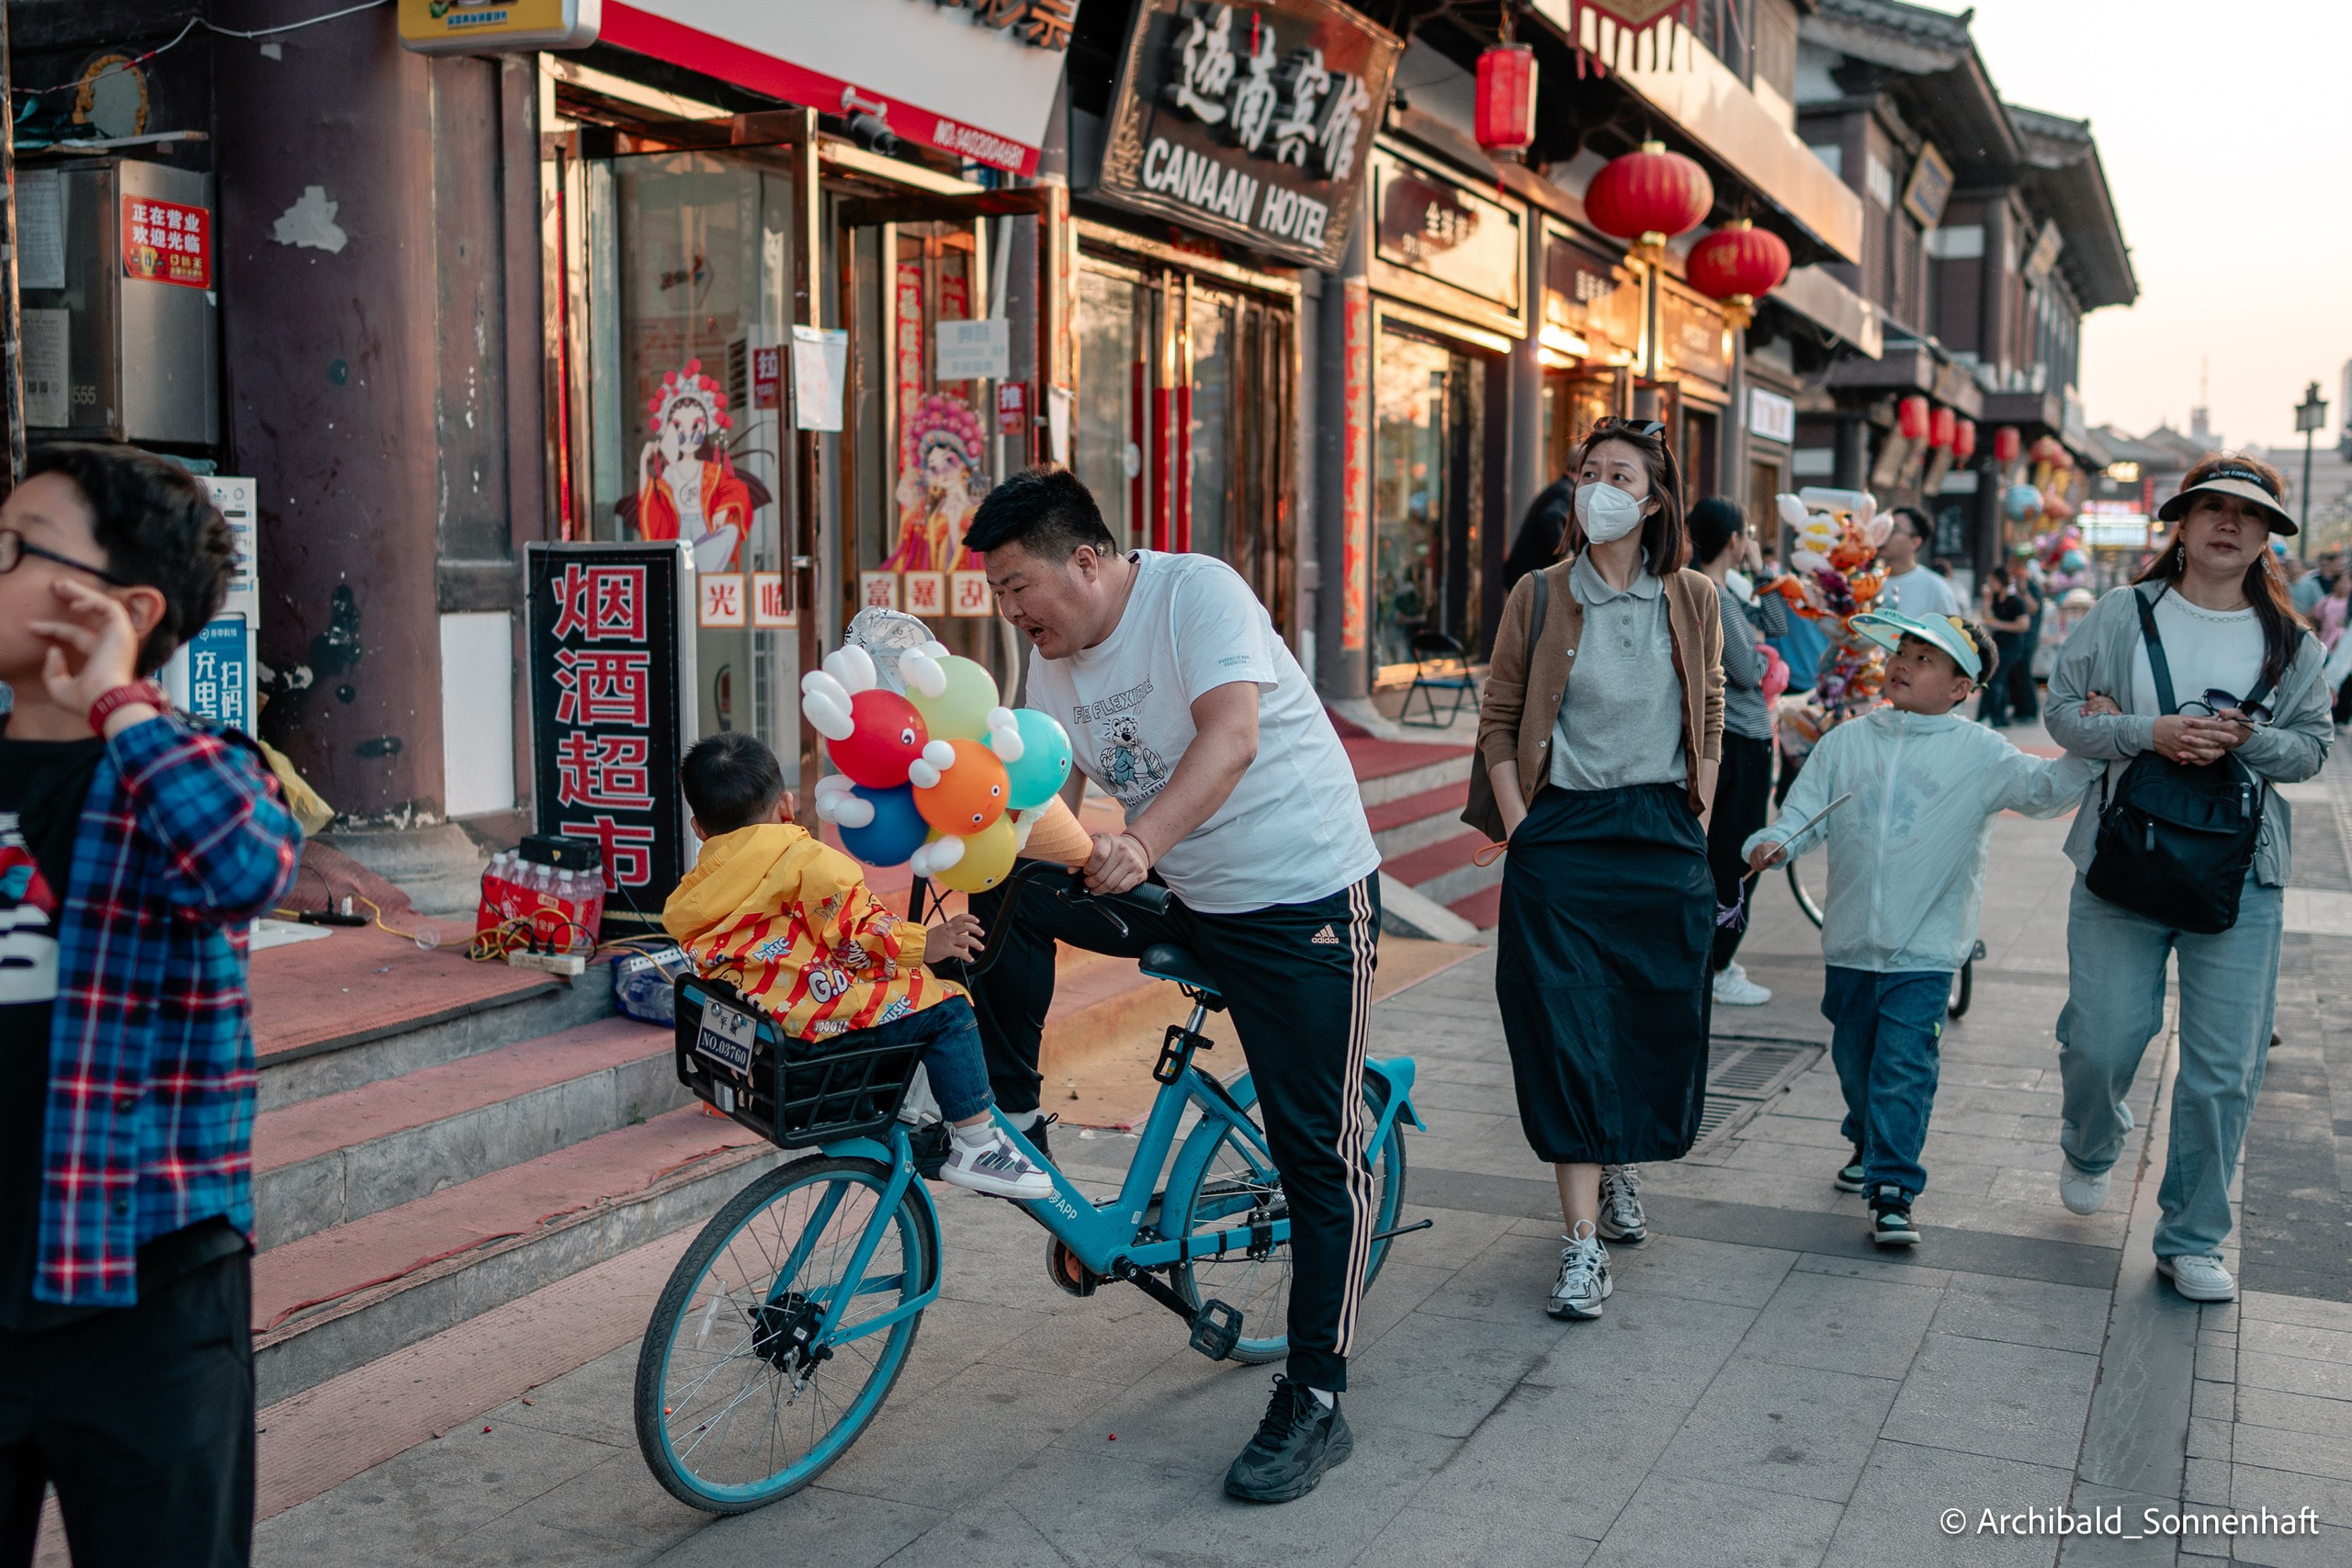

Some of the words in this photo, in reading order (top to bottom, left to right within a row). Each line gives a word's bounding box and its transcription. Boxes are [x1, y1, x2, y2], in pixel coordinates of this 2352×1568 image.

[1142, 138, 1259, 224] CANAAN
[1260, 185, 1329, 248] HOTEL
[132, 203, 200, 232] 正在营业
[131, 224, 200, 254] 欢迎光临
[550, 562, 655, 894] 烟酒超市
[752, 936, 790, 961] MUSIC
[878, 995, 911, 1026] MUSIC
[701, 1031, 747, 1066] NO.03760
